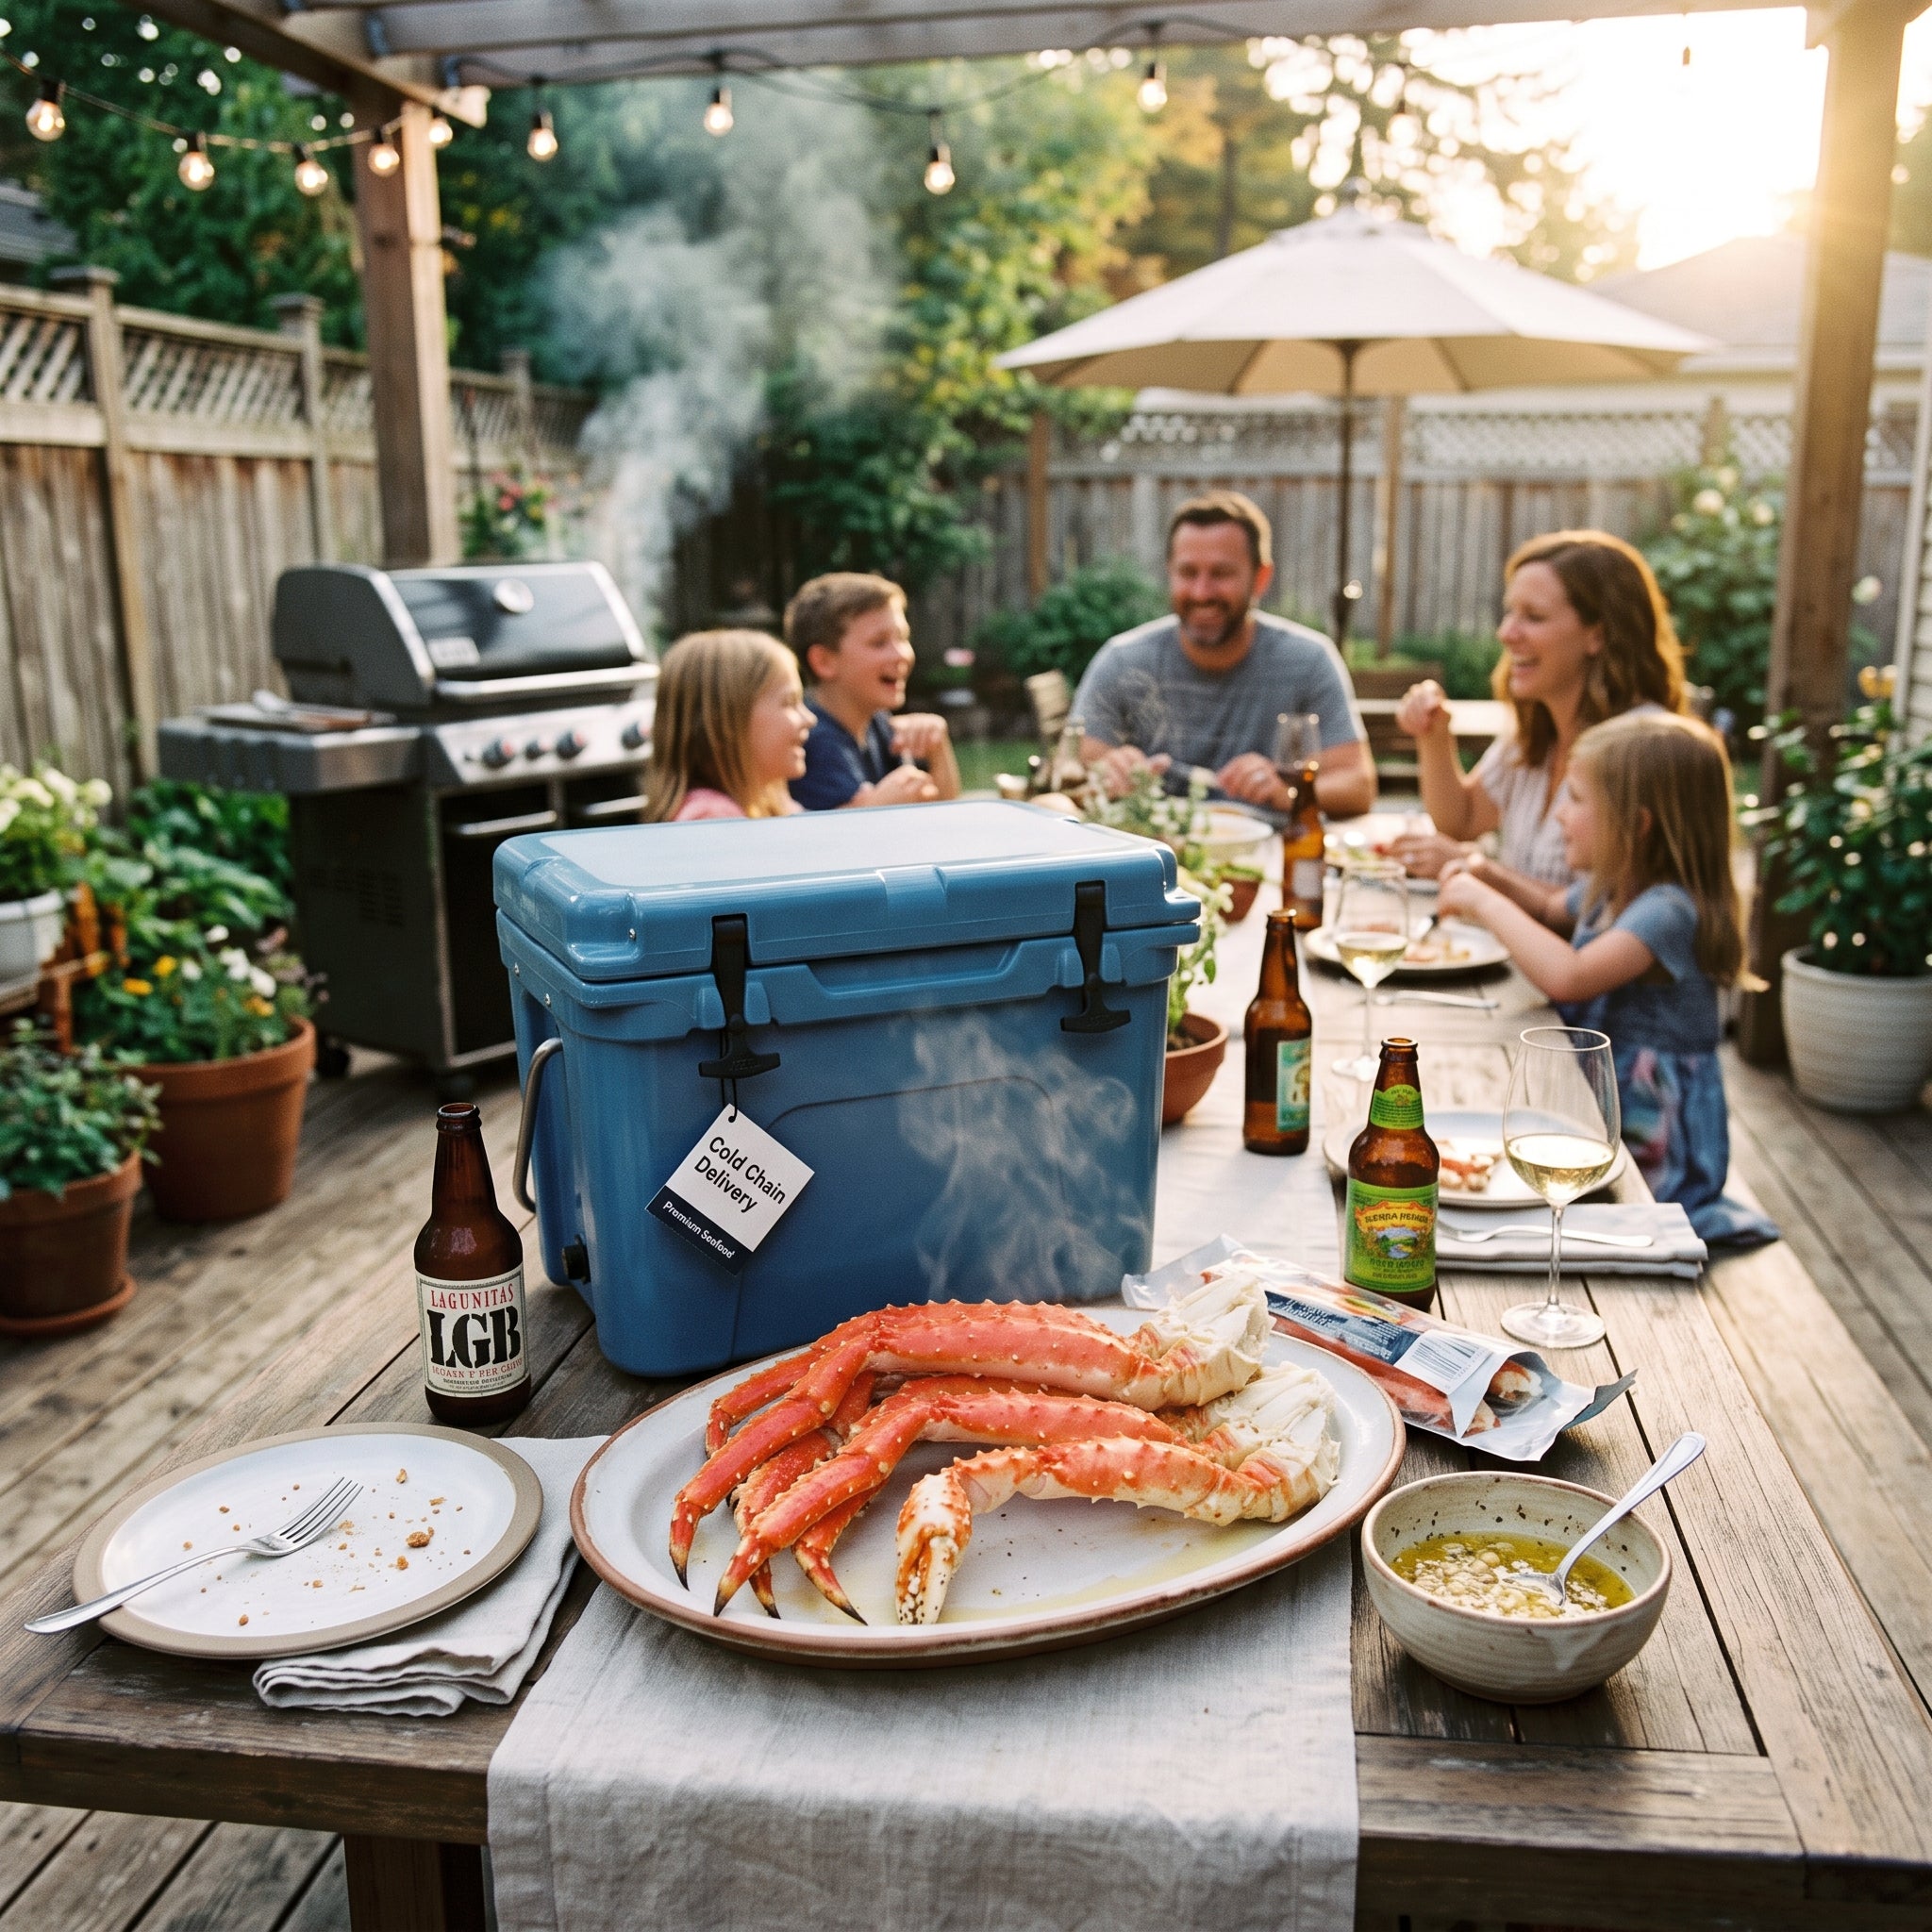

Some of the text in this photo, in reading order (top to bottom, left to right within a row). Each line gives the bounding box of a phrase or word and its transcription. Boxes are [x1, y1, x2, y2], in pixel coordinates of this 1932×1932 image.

[694, 1156, 758, 1213] Delivery
[709, 1137, 786, 1204] Cold Chain
[431, 1283, 514, 1310] LAGUNITAS
[426, 1306, 521, 1369] LGB
